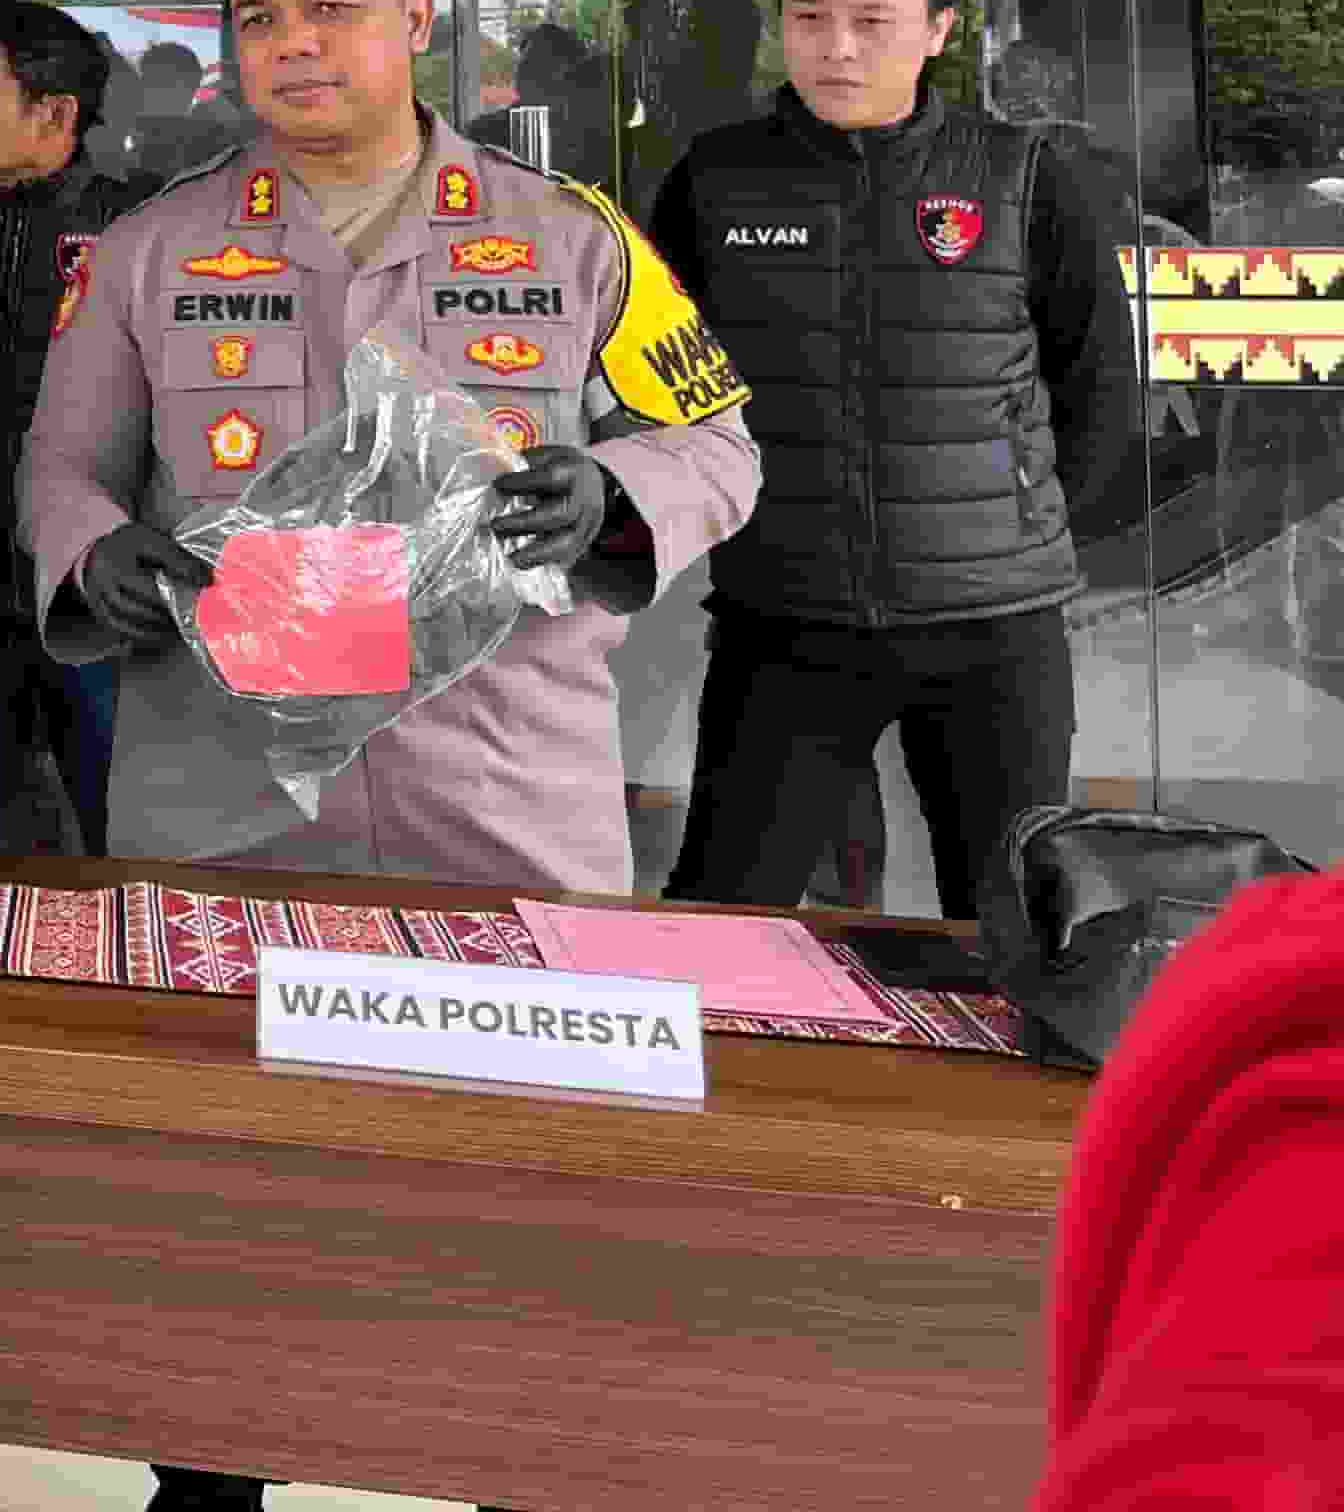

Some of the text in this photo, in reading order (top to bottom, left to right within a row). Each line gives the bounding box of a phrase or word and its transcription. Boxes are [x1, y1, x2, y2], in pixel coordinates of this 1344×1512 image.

[724, 226, 809, 246] ALVAN
[174, 294, 294, 321] ERWIN
[433, 288, 563, 319] POLRI
[277, 982, 681, 1051] WAKA POLRESTA
